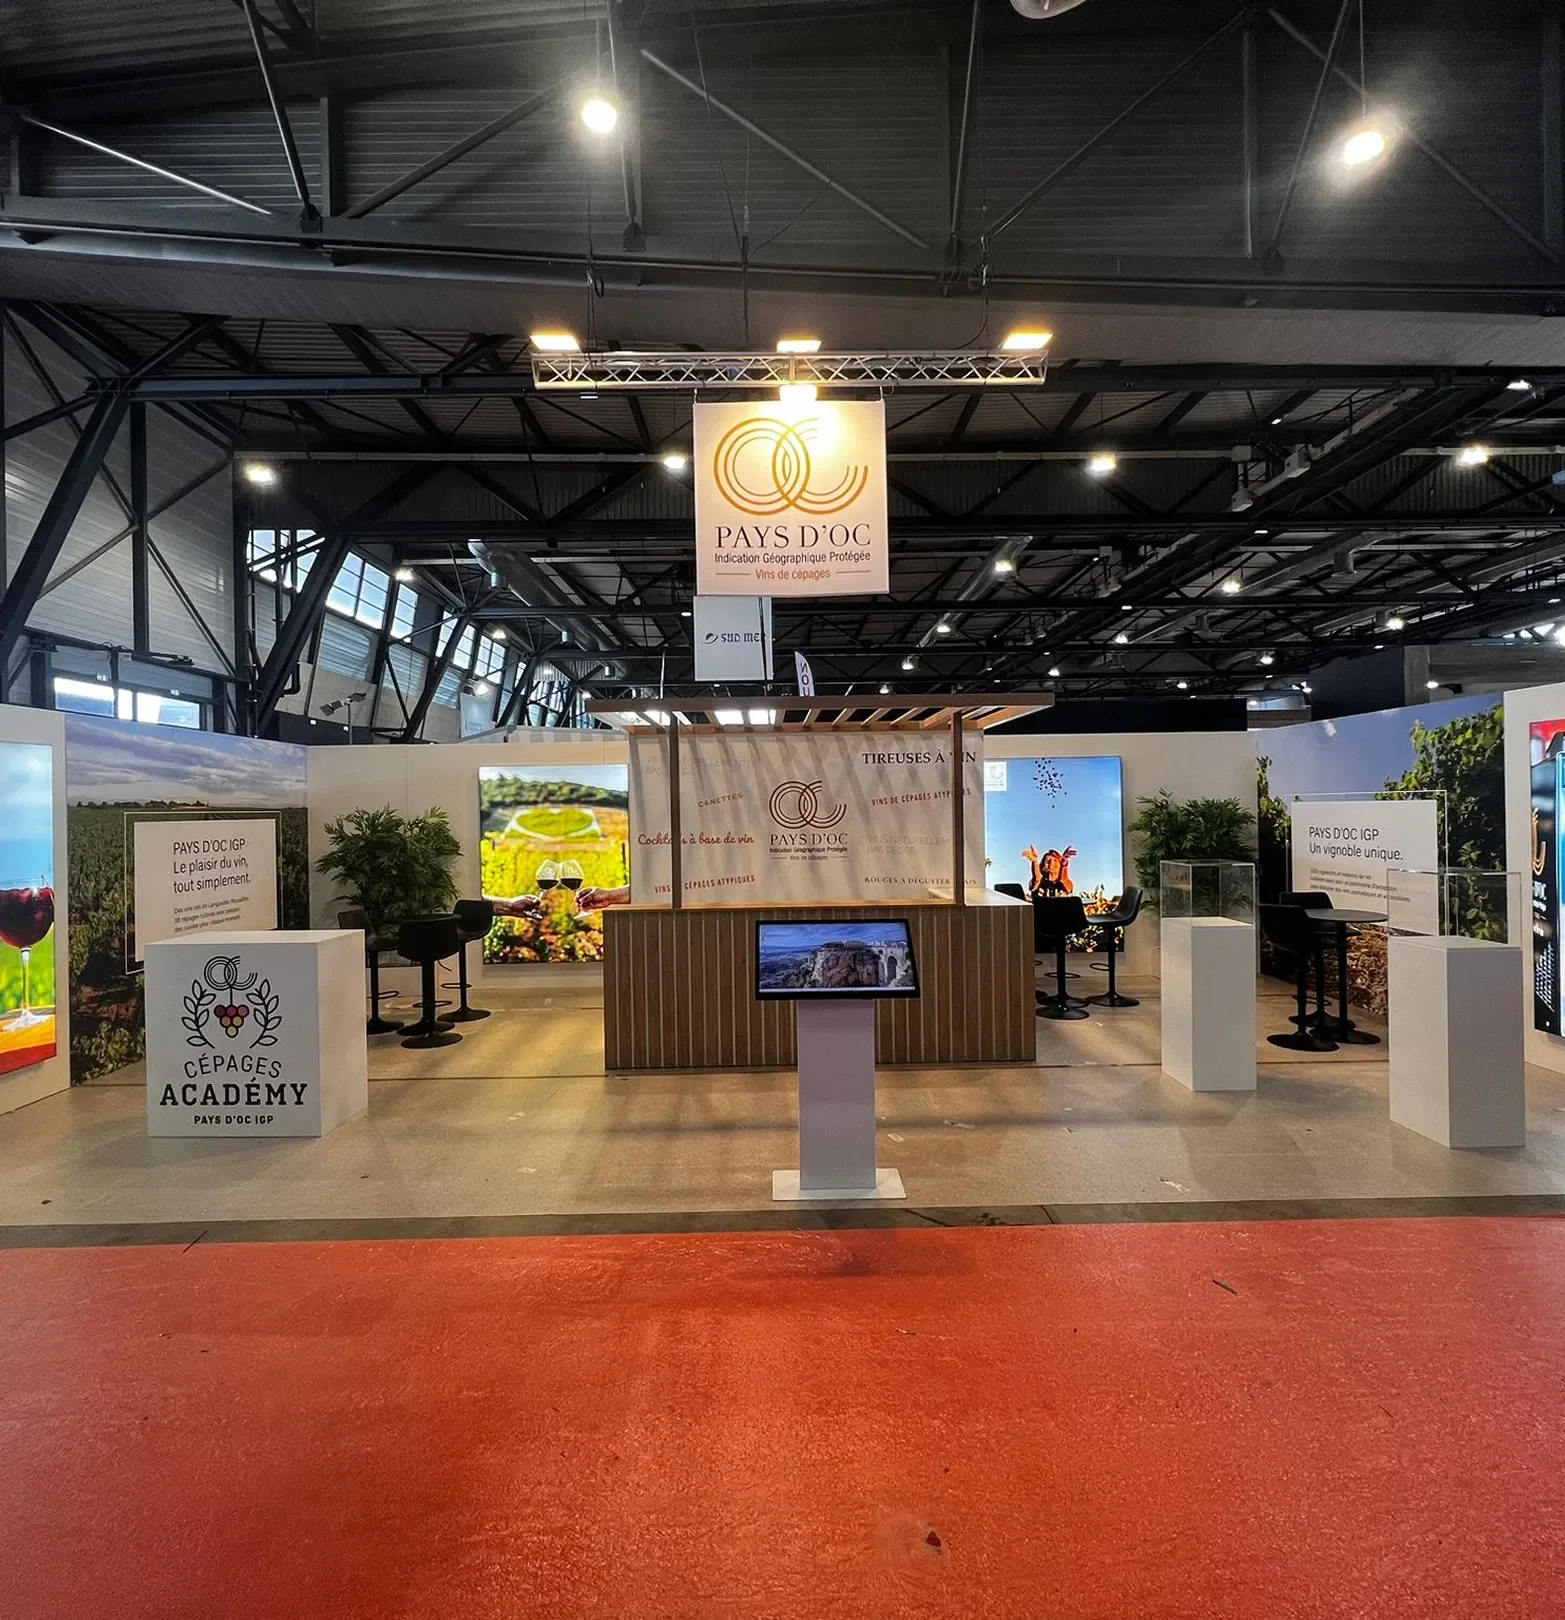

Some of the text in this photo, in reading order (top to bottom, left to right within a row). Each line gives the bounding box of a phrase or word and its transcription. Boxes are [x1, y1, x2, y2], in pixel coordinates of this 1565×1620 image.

[715, 524, 871, 548] PAYS D'OC
[714, 550, 871, 566] Indication Géographique Protégée
[755, 568, 832, 581] Vins de cépages
[720, 633, 741, 643] SUD
[862, 749, 976, 764] TIREUSES À IN
[698, 792, 743, 808] CANETTES
[901, 792, 932, 803] CÉPAGES
[638, 831, 755, 845] Cocktas à base de vin
[770, 833, 848, 846] PAYS D'OC
[1309, 826, 1380, 841] PAYS D'OC IGP
[173, 838, 246, 855] PAYS D'OC IGP
[1309, 842, 1403, 861] Un vignoble unique.
[173, 854, 248, 875] Le plaisir du vin,
[173, 872, 251, 893] tout simplement.
[654, 874, 756, 894] VINS CÉPAGES ATYPIQUES
[864, 876, 898, 884] ROUGES
[184, 1053, 282, 1078] CÉPAGES
[160, 1076, 307, 1106] ACADÉMY
[194, 1115, 274, 1125] PAYS D'OC IGP
